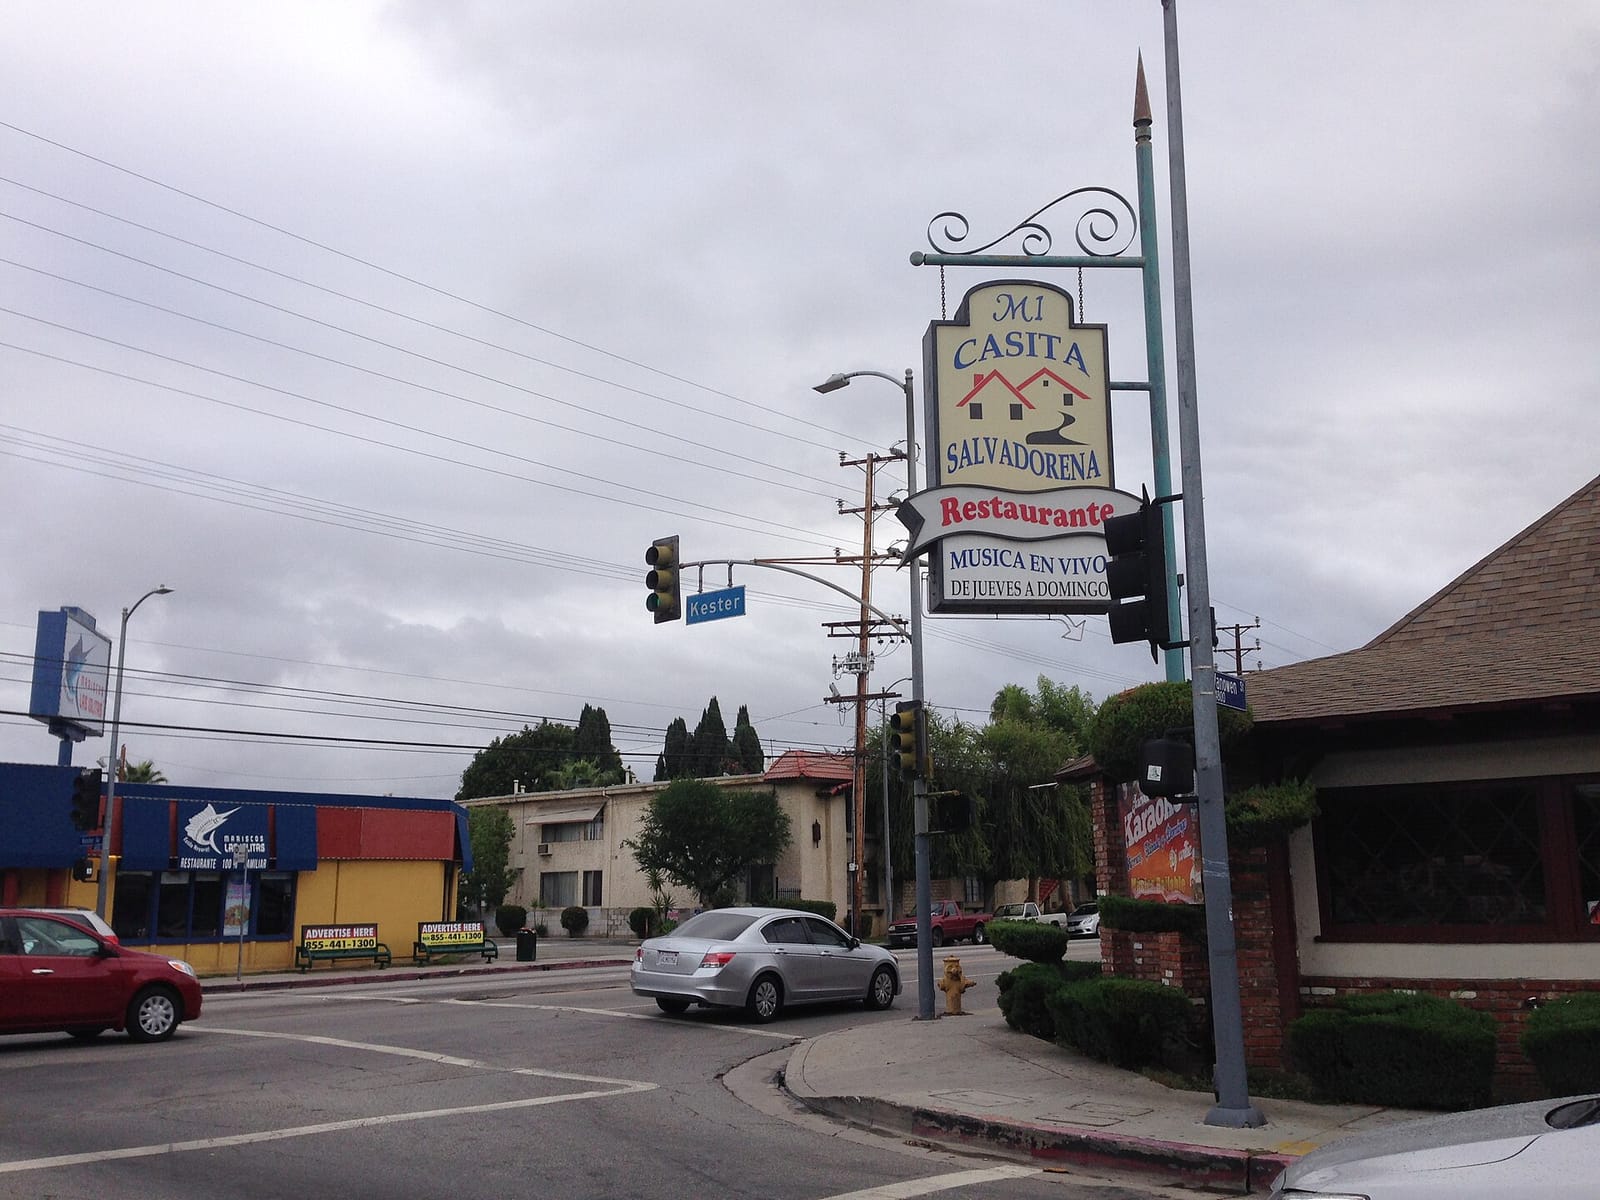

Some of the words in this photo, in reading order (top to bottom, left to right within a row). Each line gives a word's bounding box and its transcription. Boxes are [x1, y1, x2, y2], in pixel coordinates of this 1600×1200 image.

[953, 331, 1091, 378] CASITA
[946, 436, 1102, 481] SALVADORENA
[939, 496, 1115, 528] Restaurante
[950, 548, 1026, 571] MUSICA
[1030, 554, 1054, 574] EN
[1057, 554, 1108, 576] VIVO
[951, 580, 970, 596] DE
[971, 580, 1021, 600] JUEVES
[1024, 581, 1035, 597] A
[1037, 580, 1109, 597] DOMINGO
[690, 596, 740, 617] Kester
[223, 835, 264, 843] MARISCOS
[180, 857, 217, 870] RESTAURANTE
[245, 858, 267, 870] AMILIAR
[305, 928, 352, 939] ADVERTISE
[353, 926, 375, 938] HERE
[422, 923, 462, 933] ADVERTISE
[463, 922, 481, 932] HERE
[305, 938, 375, 950] 855-441-1300
[430, 932, 482, 941] 855-441-1300
